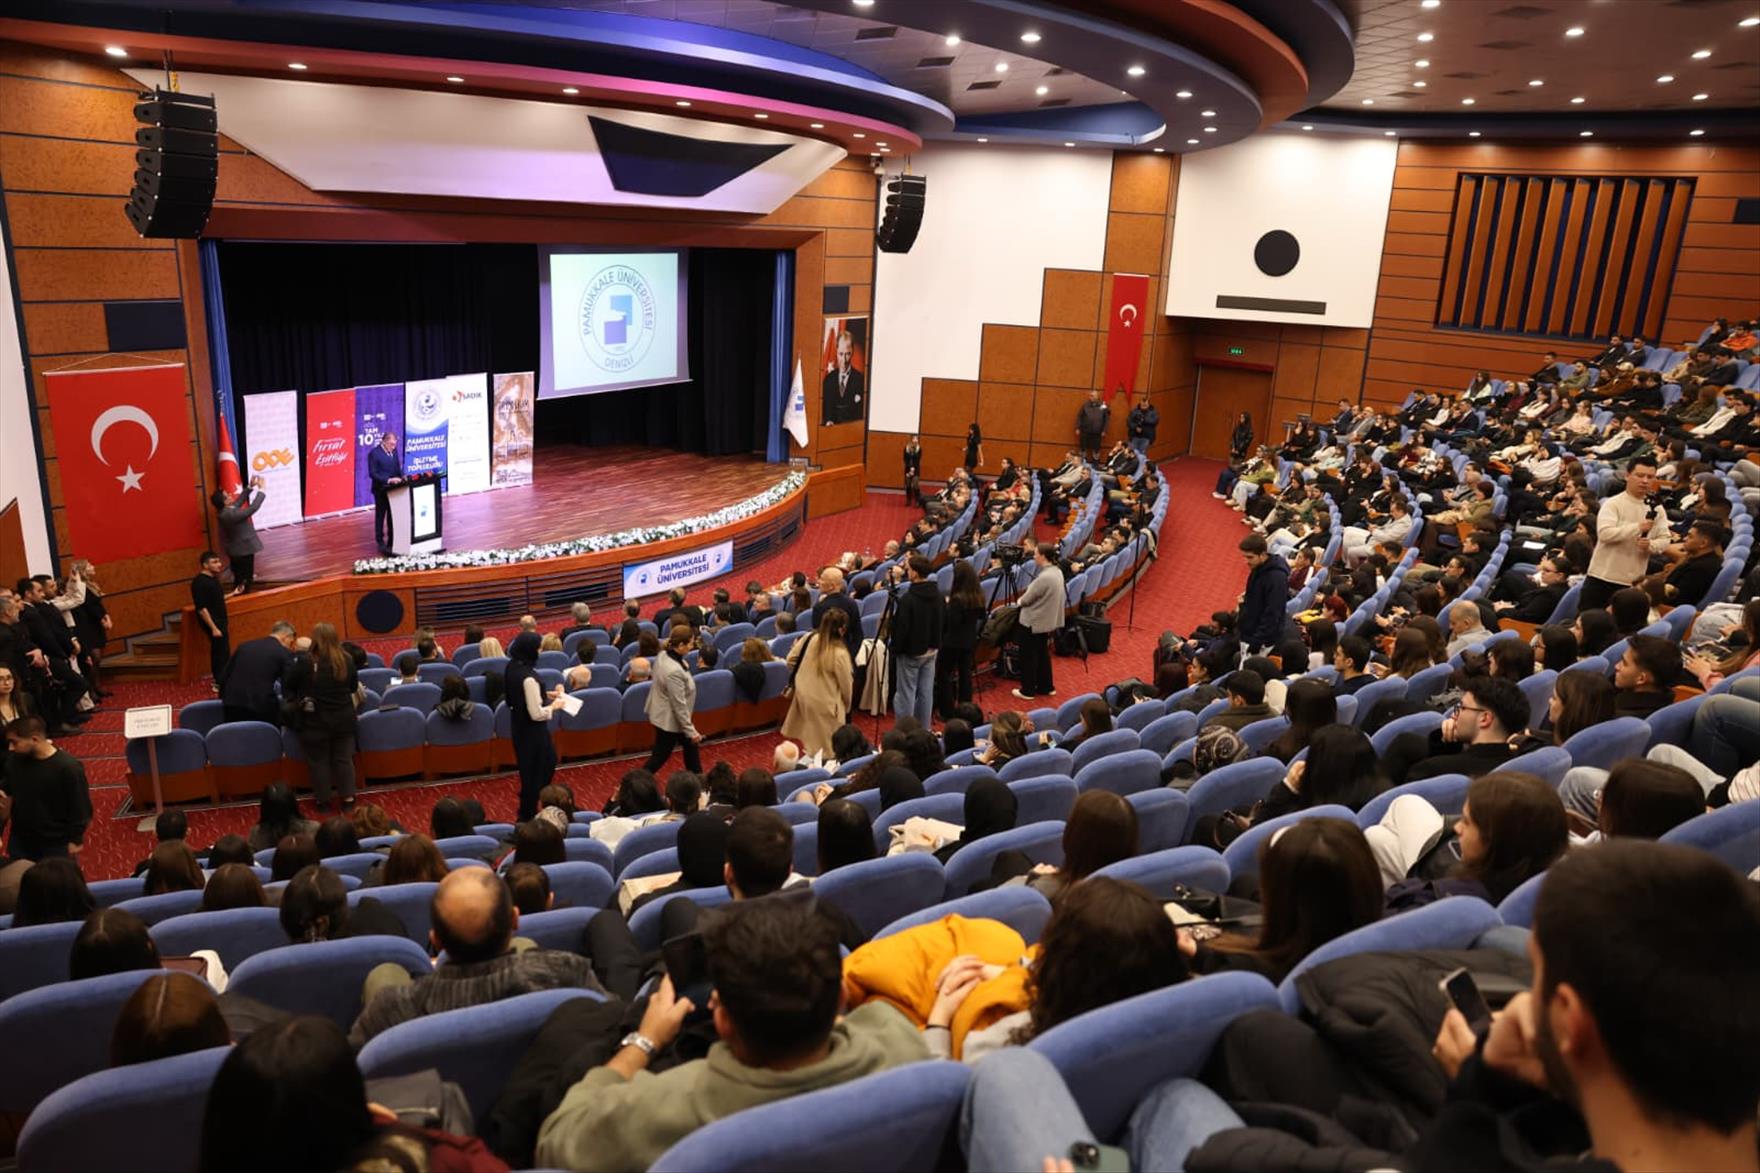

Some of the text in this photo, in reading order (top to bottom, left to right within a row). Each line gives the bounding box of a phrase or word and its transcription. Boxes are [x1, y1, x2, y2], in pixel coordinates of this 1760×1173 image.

[582, 271, 615, 336] PAMUKKALE
[358, 434, 374, 447] 10
[407, 434, 445, 445] PAMUKKALE
[657, 562, 709, 584] ÜNİVERSİTESİ
[660, 553, 707, 573] PAMUKKALE
